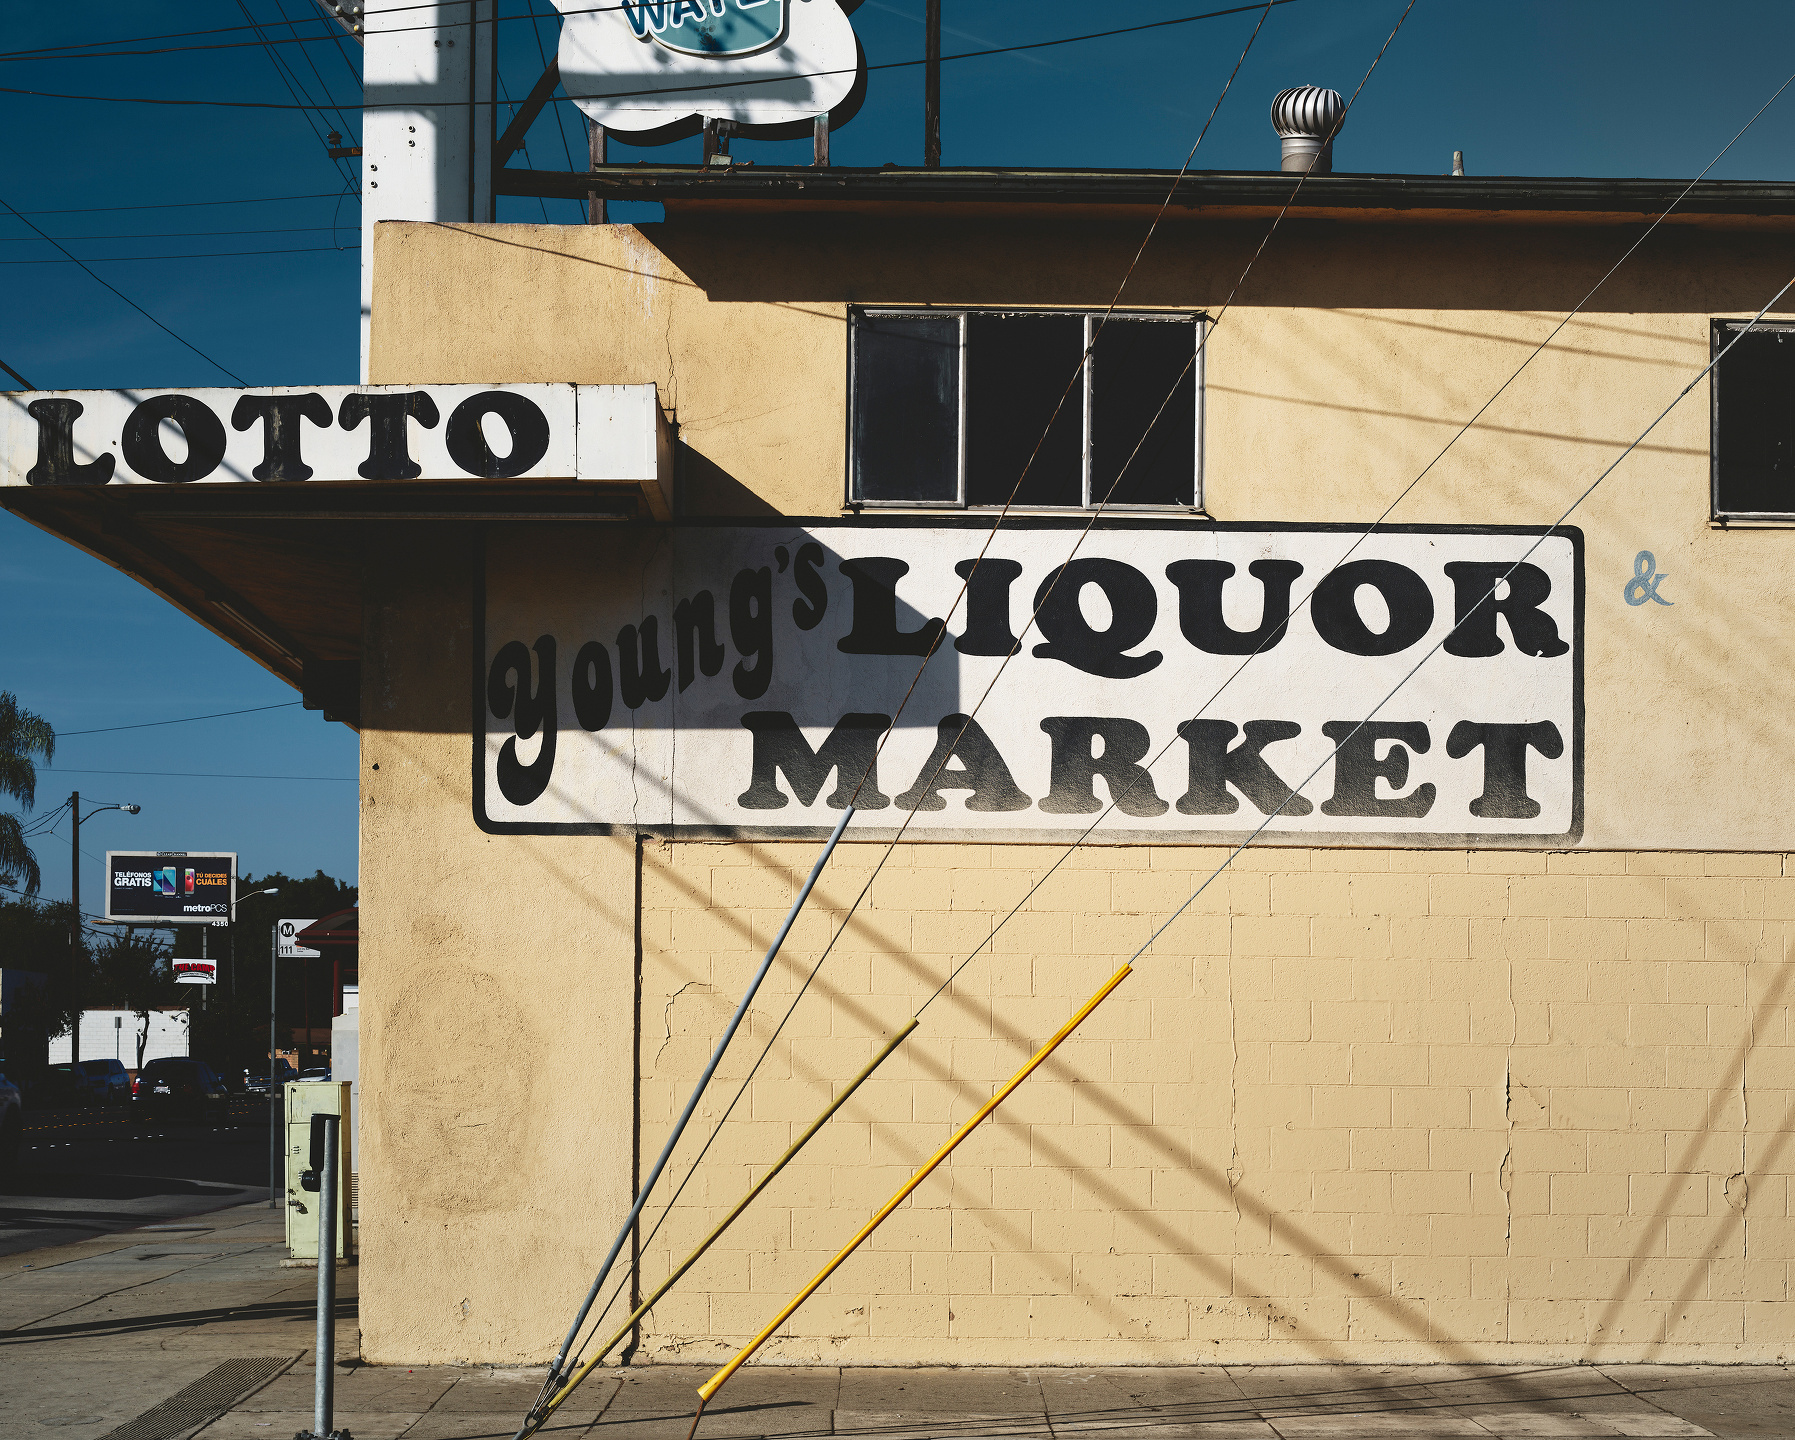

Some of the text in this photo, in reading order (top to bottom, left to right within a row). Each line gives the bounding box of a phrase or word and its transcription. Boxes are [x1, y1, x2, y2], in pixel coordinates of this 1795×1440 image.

[26, 390, 550, 486] LOTTO
[1623, 550, 1674, 607] &
[837, 556, 1569, 679] LIQUOR
[737, 710, 1565, 820] MARKET
[114, 878, 152, 887] GRATIS
[183, 903, 228, 912] metroPCS
[280, 946, 292, 954] 111
[173, 963, 215, 972] THE CAMP
